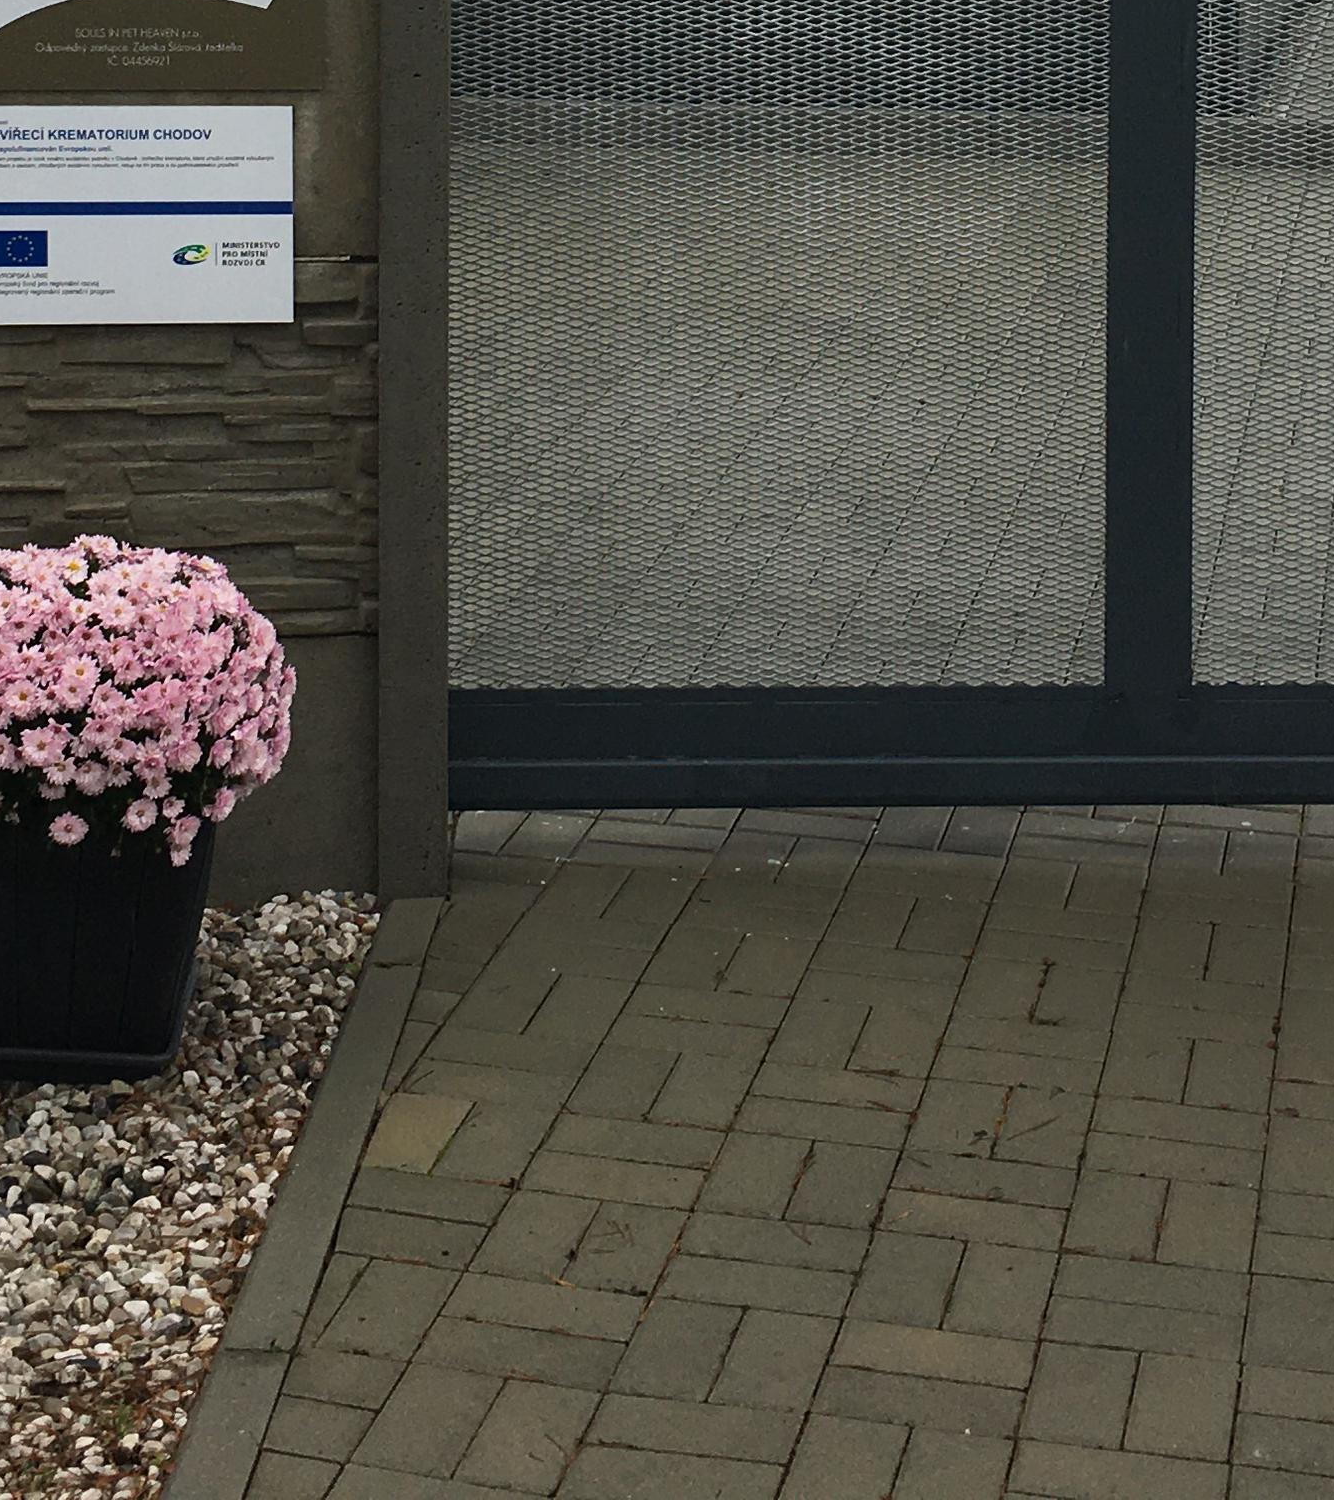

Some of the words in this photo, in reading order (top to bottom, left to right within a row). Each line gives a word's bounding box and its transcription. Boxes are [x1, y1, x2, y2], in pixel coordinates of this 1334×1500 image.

[48, 130, 149, 140] KREMATORIUM
[153, 129, 211, 140] CHODOV
[221, 241, 281, 249] MINISTERSTVO
[221, 250, 238, 258] PRO
[221, 259, 253, 267] ROZVOJ
